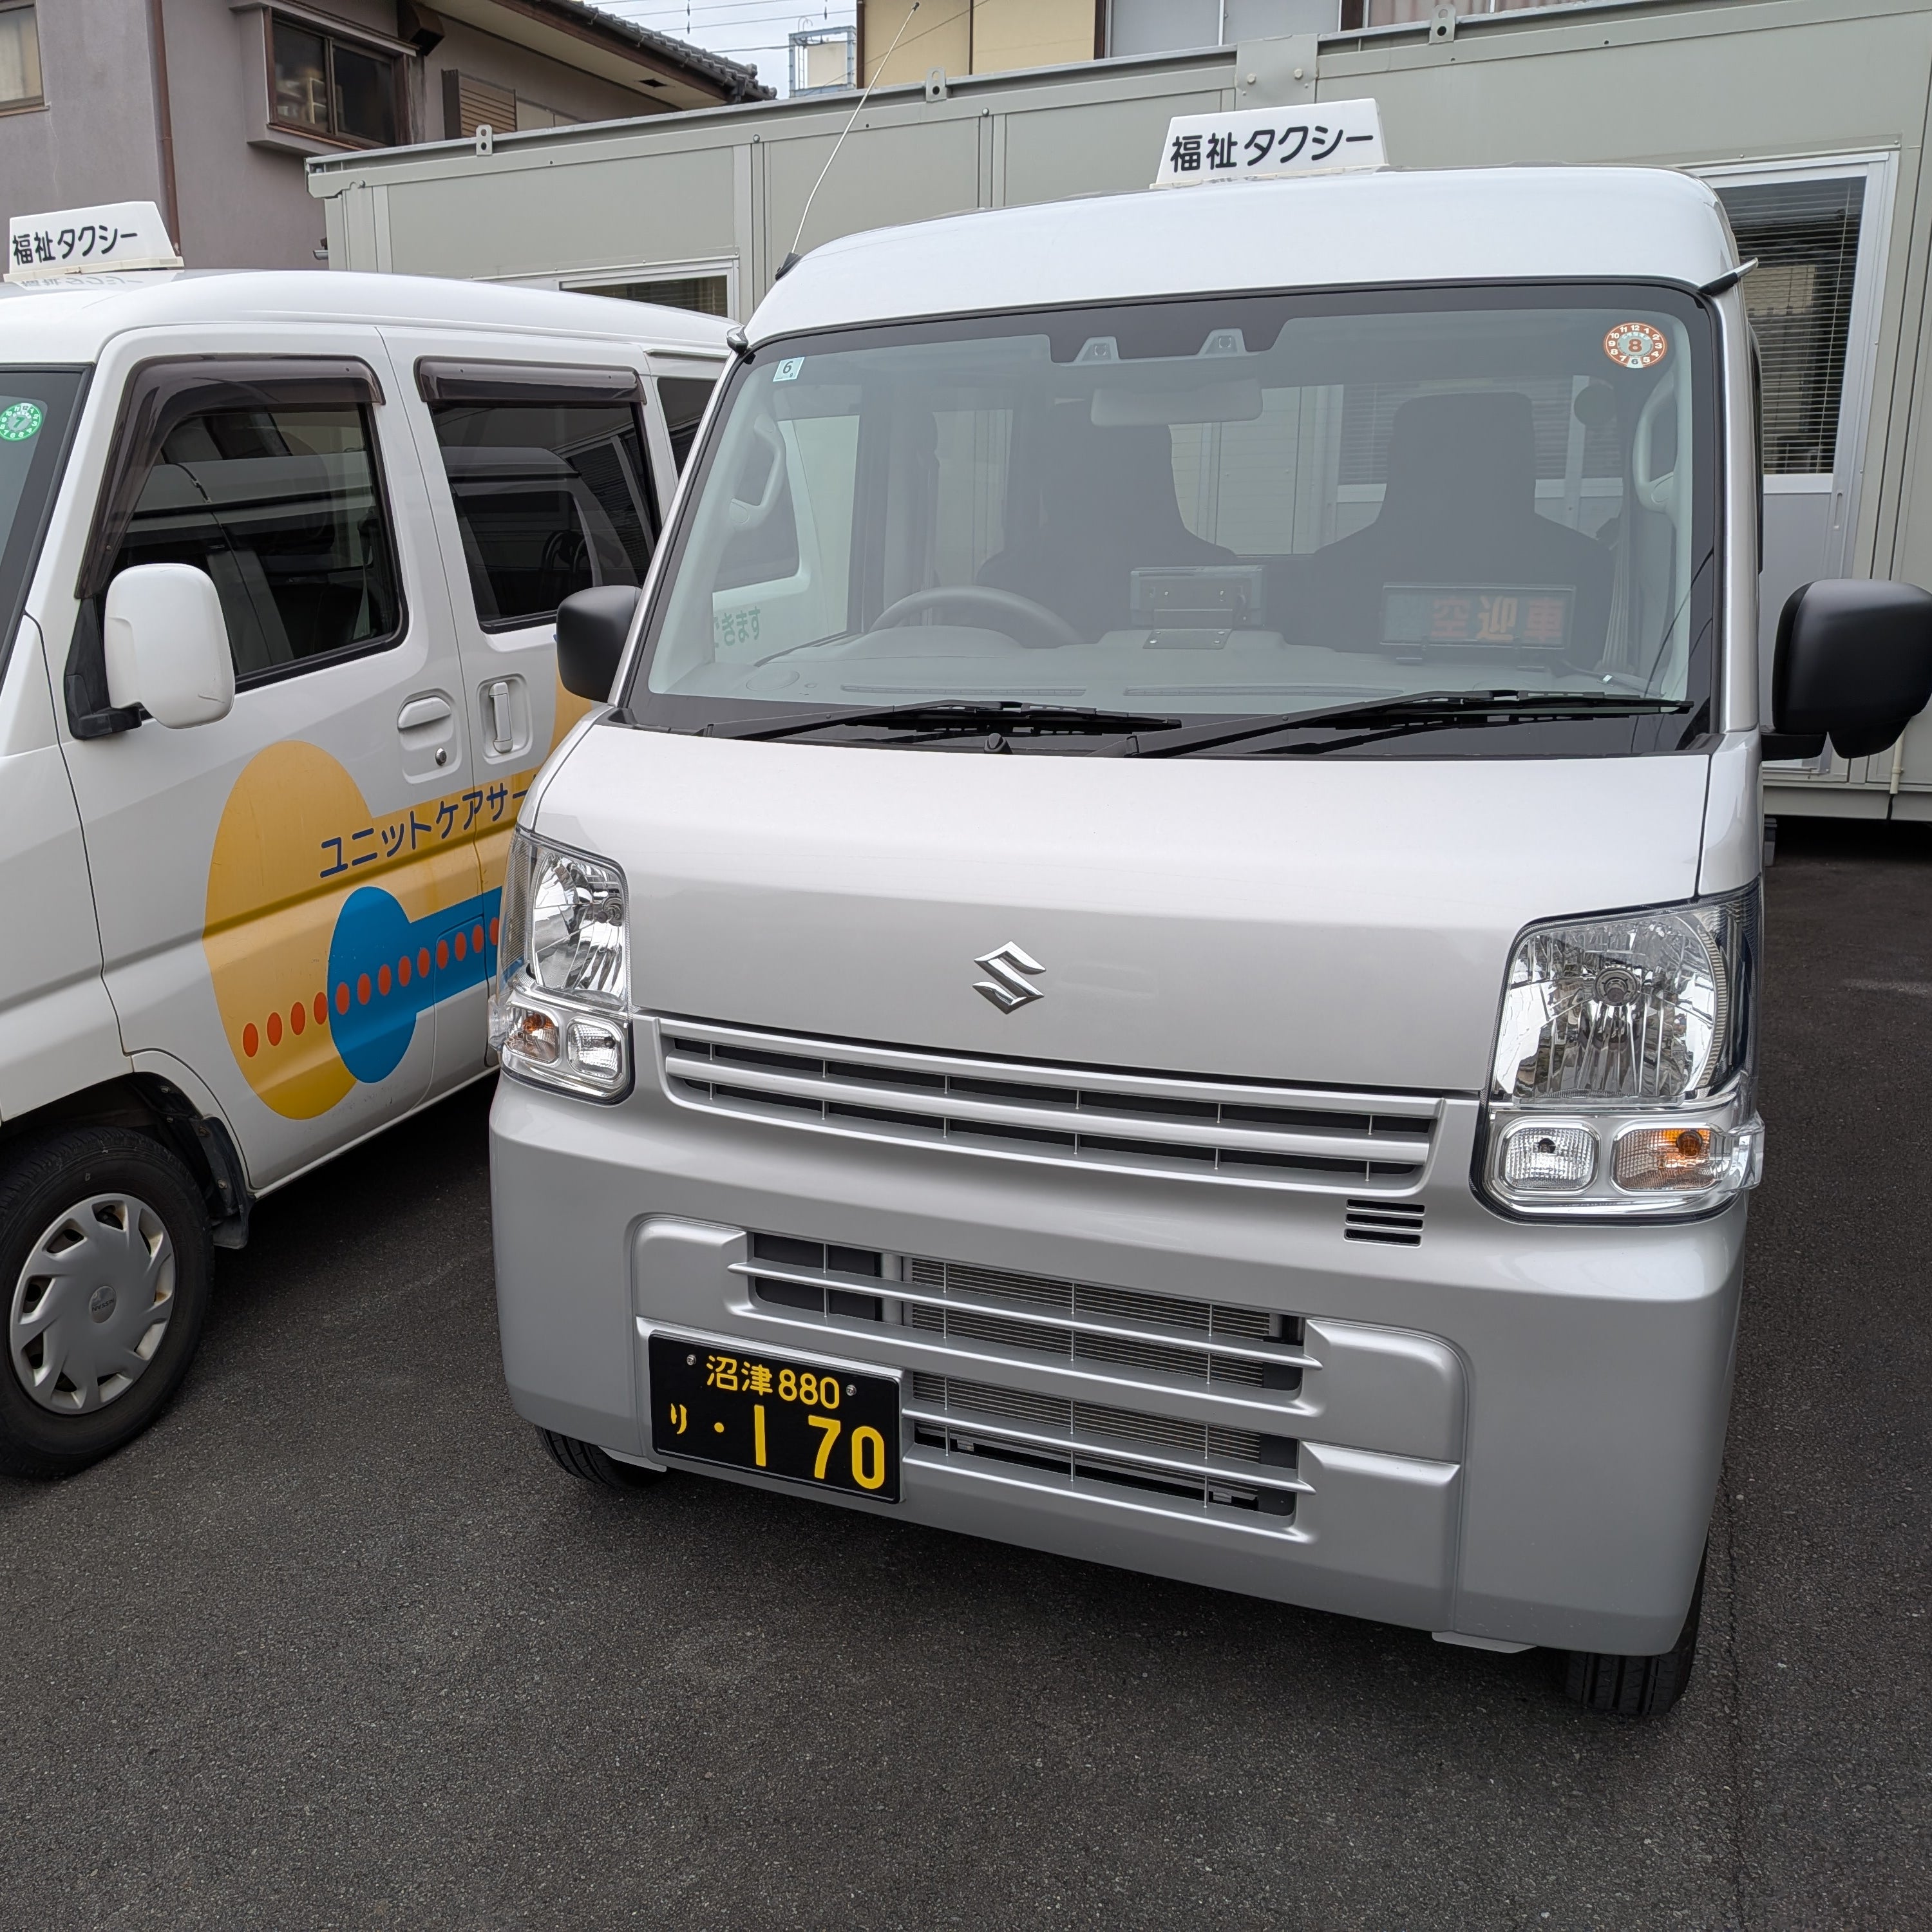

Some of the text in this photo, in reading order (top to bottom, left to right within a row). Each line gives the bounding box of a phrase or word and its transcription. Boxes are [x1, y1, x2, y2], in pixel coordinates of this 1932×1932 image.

[1170, 126, 1374, 173] 福祉タクシー
[12, 225, 138, 265] 福祉タクシー
[1628, 338, 1642, 352] 8
[782, 360, 793, 374] 6
[13, 416, 25, 428] 7
[320, 773, 536, 878] ユニットケアサー
[706, 1355, 840, 1409] 沼津 880
[670, 1403, 687, 1435] り
